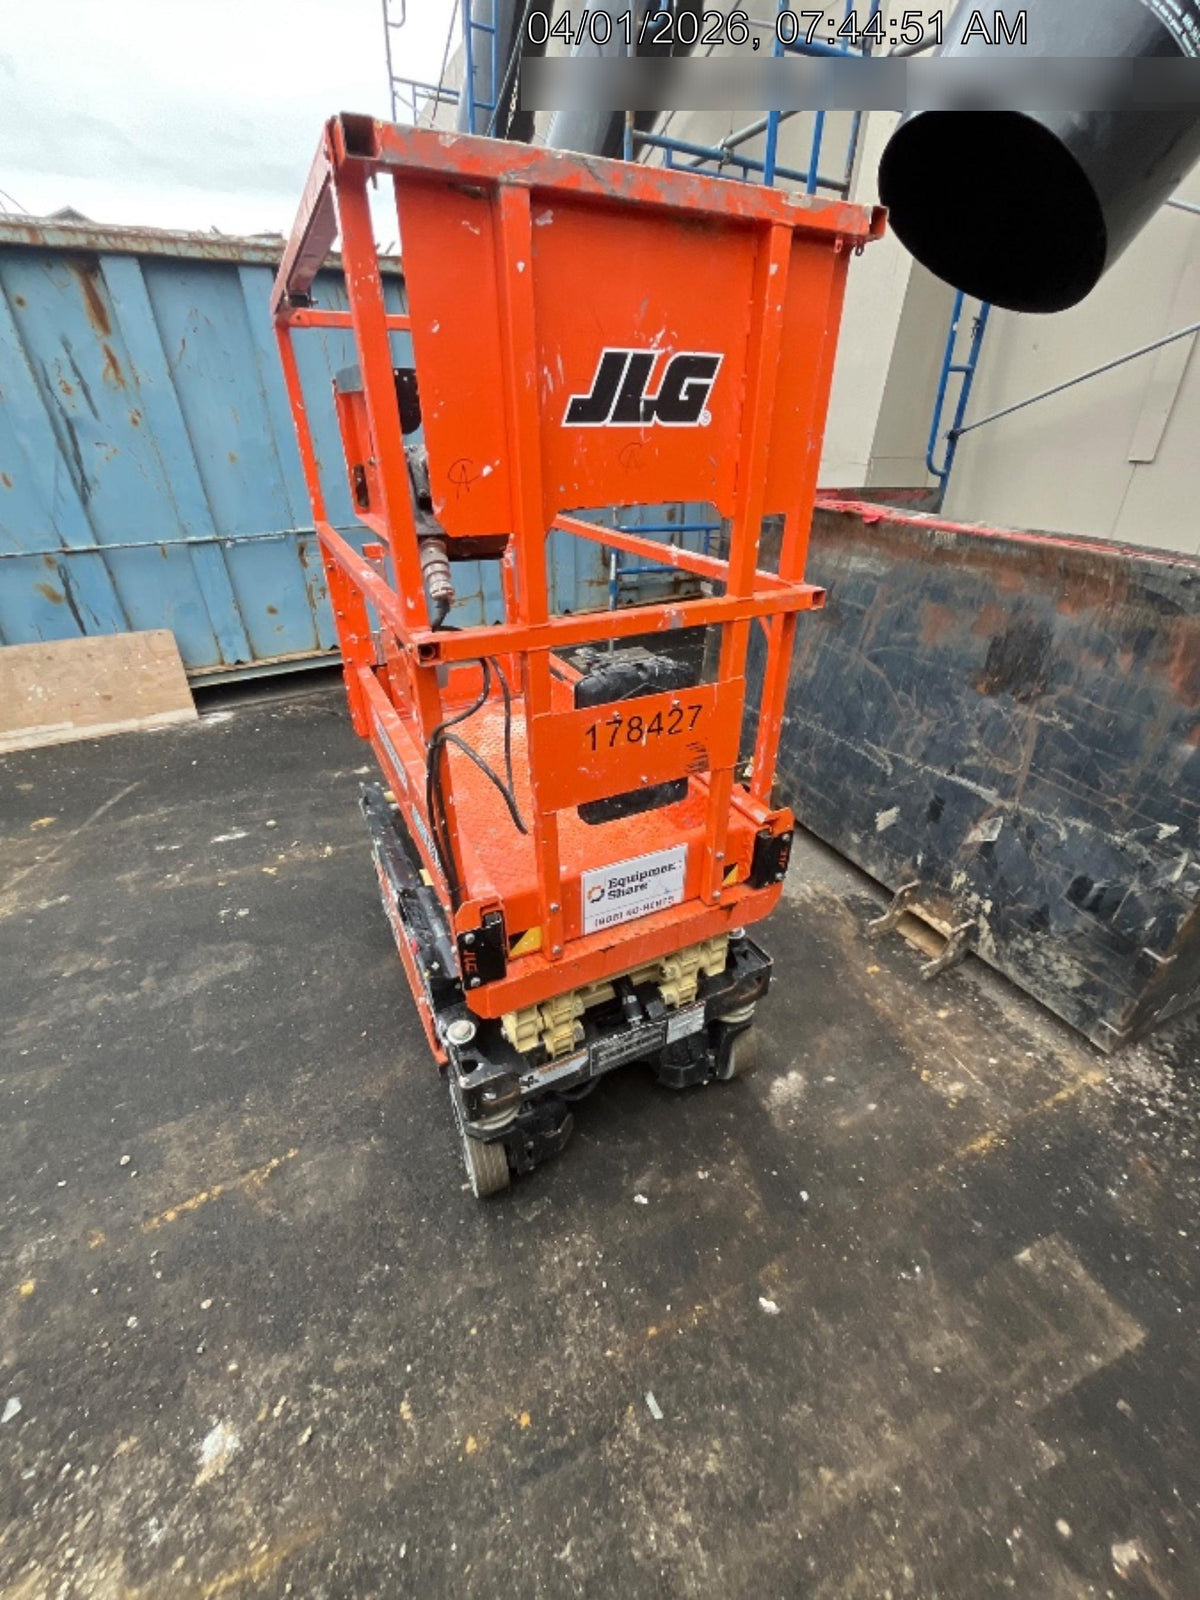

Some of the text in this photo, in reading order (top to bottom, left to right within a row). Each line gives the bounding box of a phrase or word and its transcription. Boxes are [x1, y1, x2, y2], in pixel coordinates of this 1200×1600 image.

[561, 347, 724, 427] JLG
[585, 705, 702, 751] 178427
[607, 859, 682, 890] Equipmen
[607, 882, 648, 900] Share
